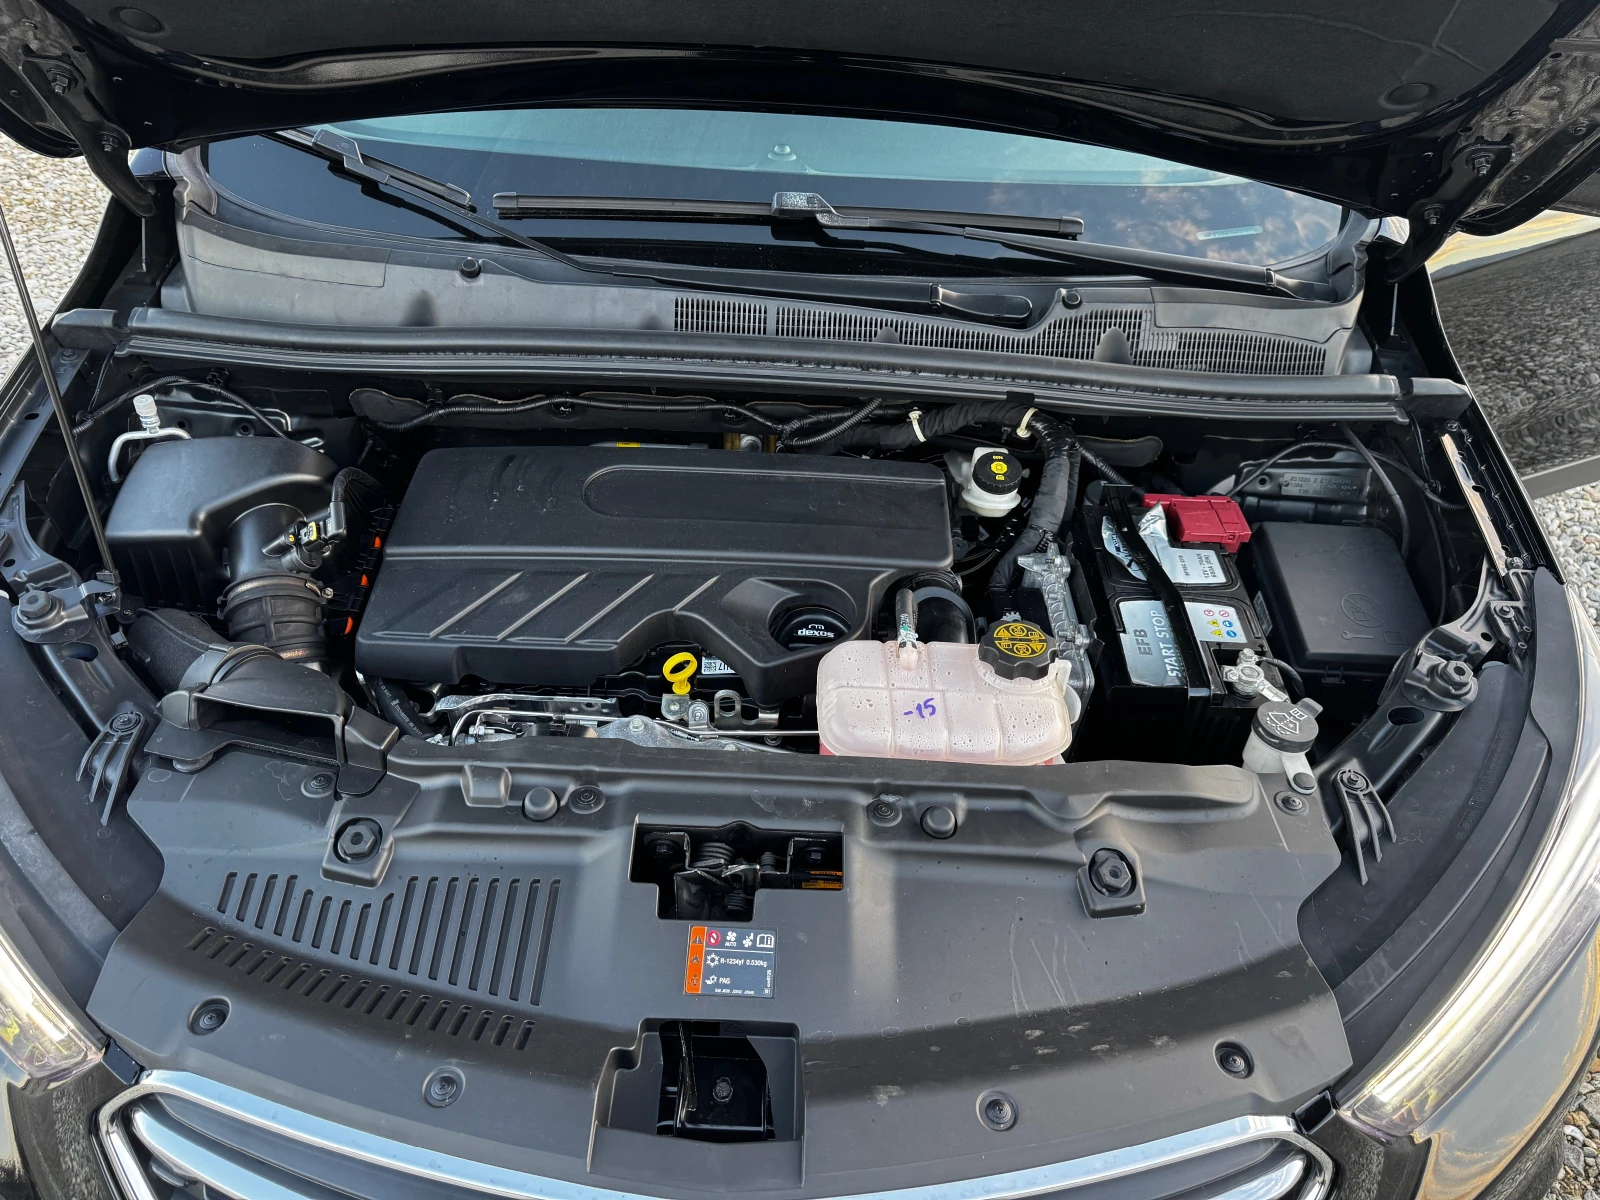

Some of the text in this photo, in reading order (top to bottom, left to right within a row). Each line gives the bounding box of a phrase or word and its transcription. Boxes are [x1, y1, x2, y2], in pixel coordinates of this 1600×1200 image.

[797, 627, 836, 638] dexos
[1133, 628, 1153, 656] EFB
[1150, 610, 1182, 678] START STOP
[903, 697, 937, 719] -15
[720, 957, 744, 966] R-1234yf
[718, 977, 731, 985] PAG
